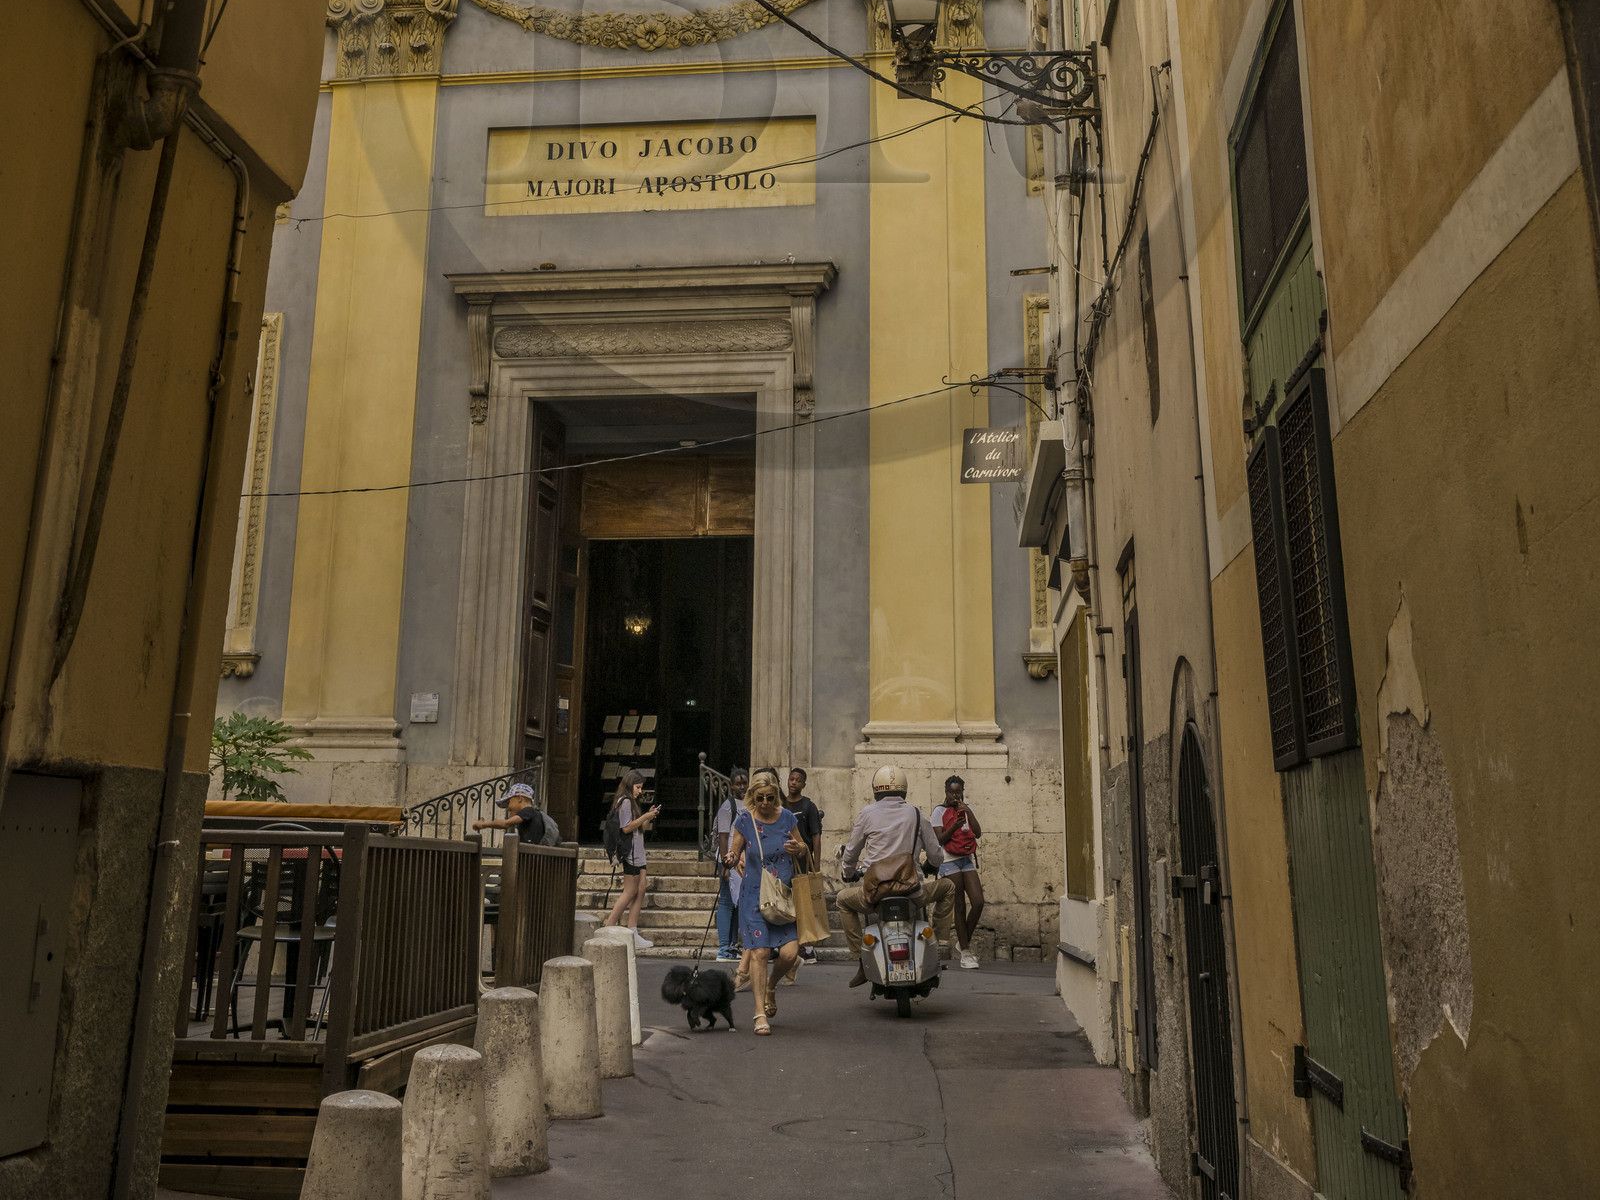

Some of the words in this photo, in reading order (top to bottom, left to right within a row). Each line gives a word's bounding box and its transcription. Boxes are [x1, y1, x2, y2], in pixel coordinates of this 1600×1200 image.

[546, 140, 618, 161] DIVO
[639, 135, 758, 158] JACOBO
[526, 178, 616, 197] MAJORI
[637, 173, 776, 195] APOSTOLO
[970, 431, 1019, 444] l'Atelier
[985, 448, 1001, 460] du
[964, 466, 1021, 479] Carnivore
